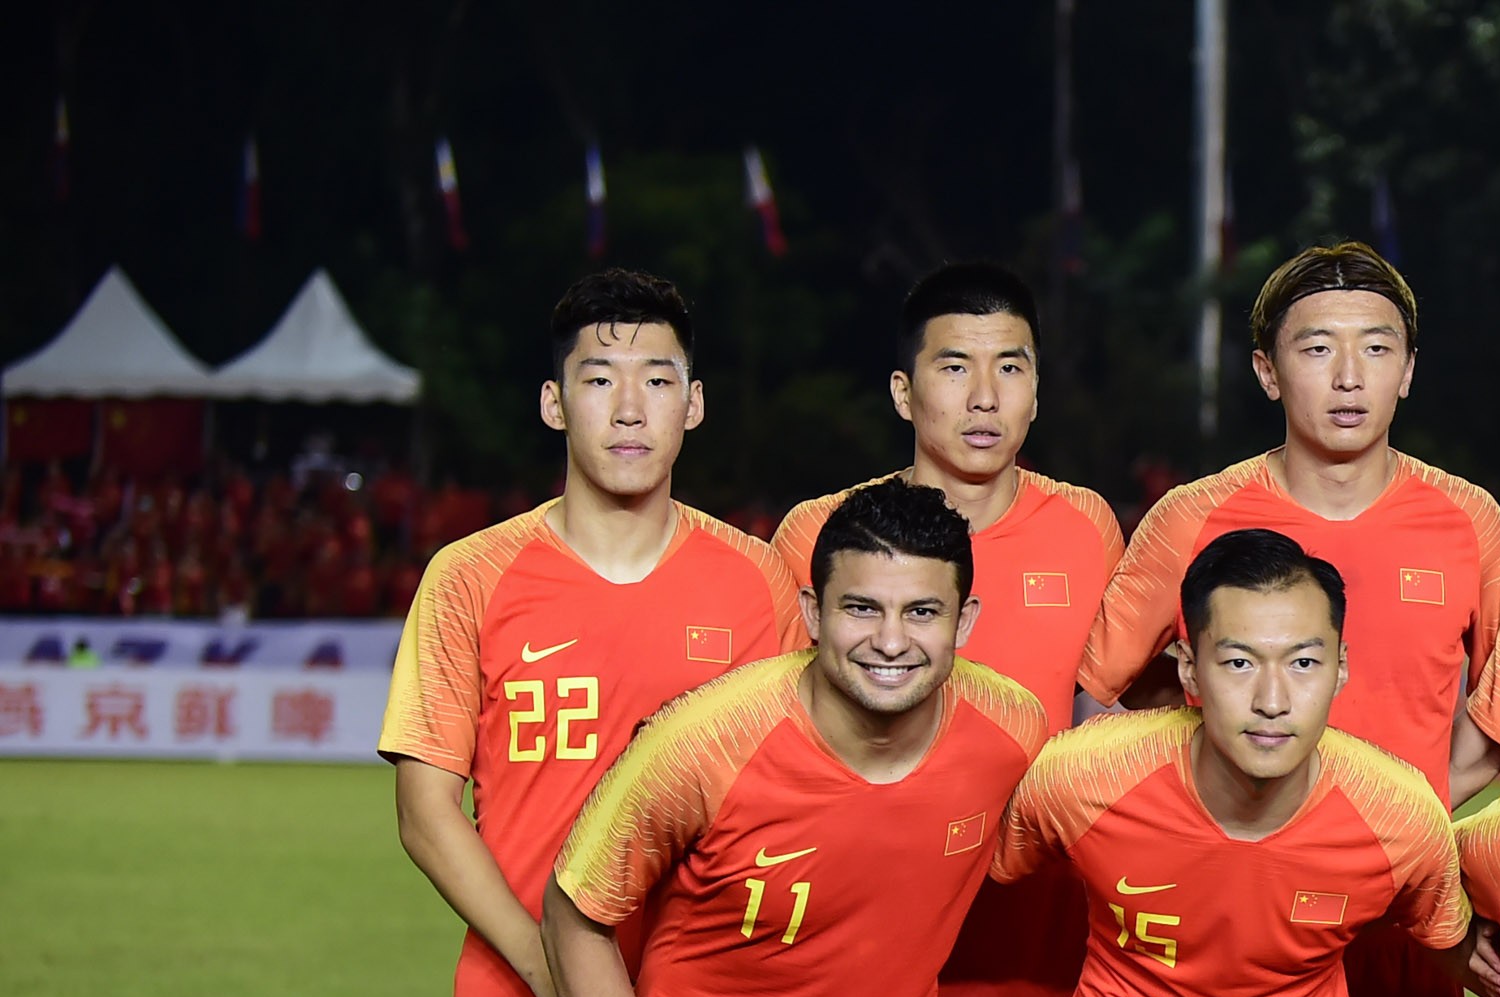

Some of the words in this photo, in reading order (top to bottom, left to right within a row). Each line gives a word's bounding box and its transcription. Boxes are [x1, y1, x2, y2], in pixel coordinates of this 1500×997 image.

[504, 676, 599, 762] 22
[740, 878, 812, 945] 11
[1108, 902, 1181, 968] 15
